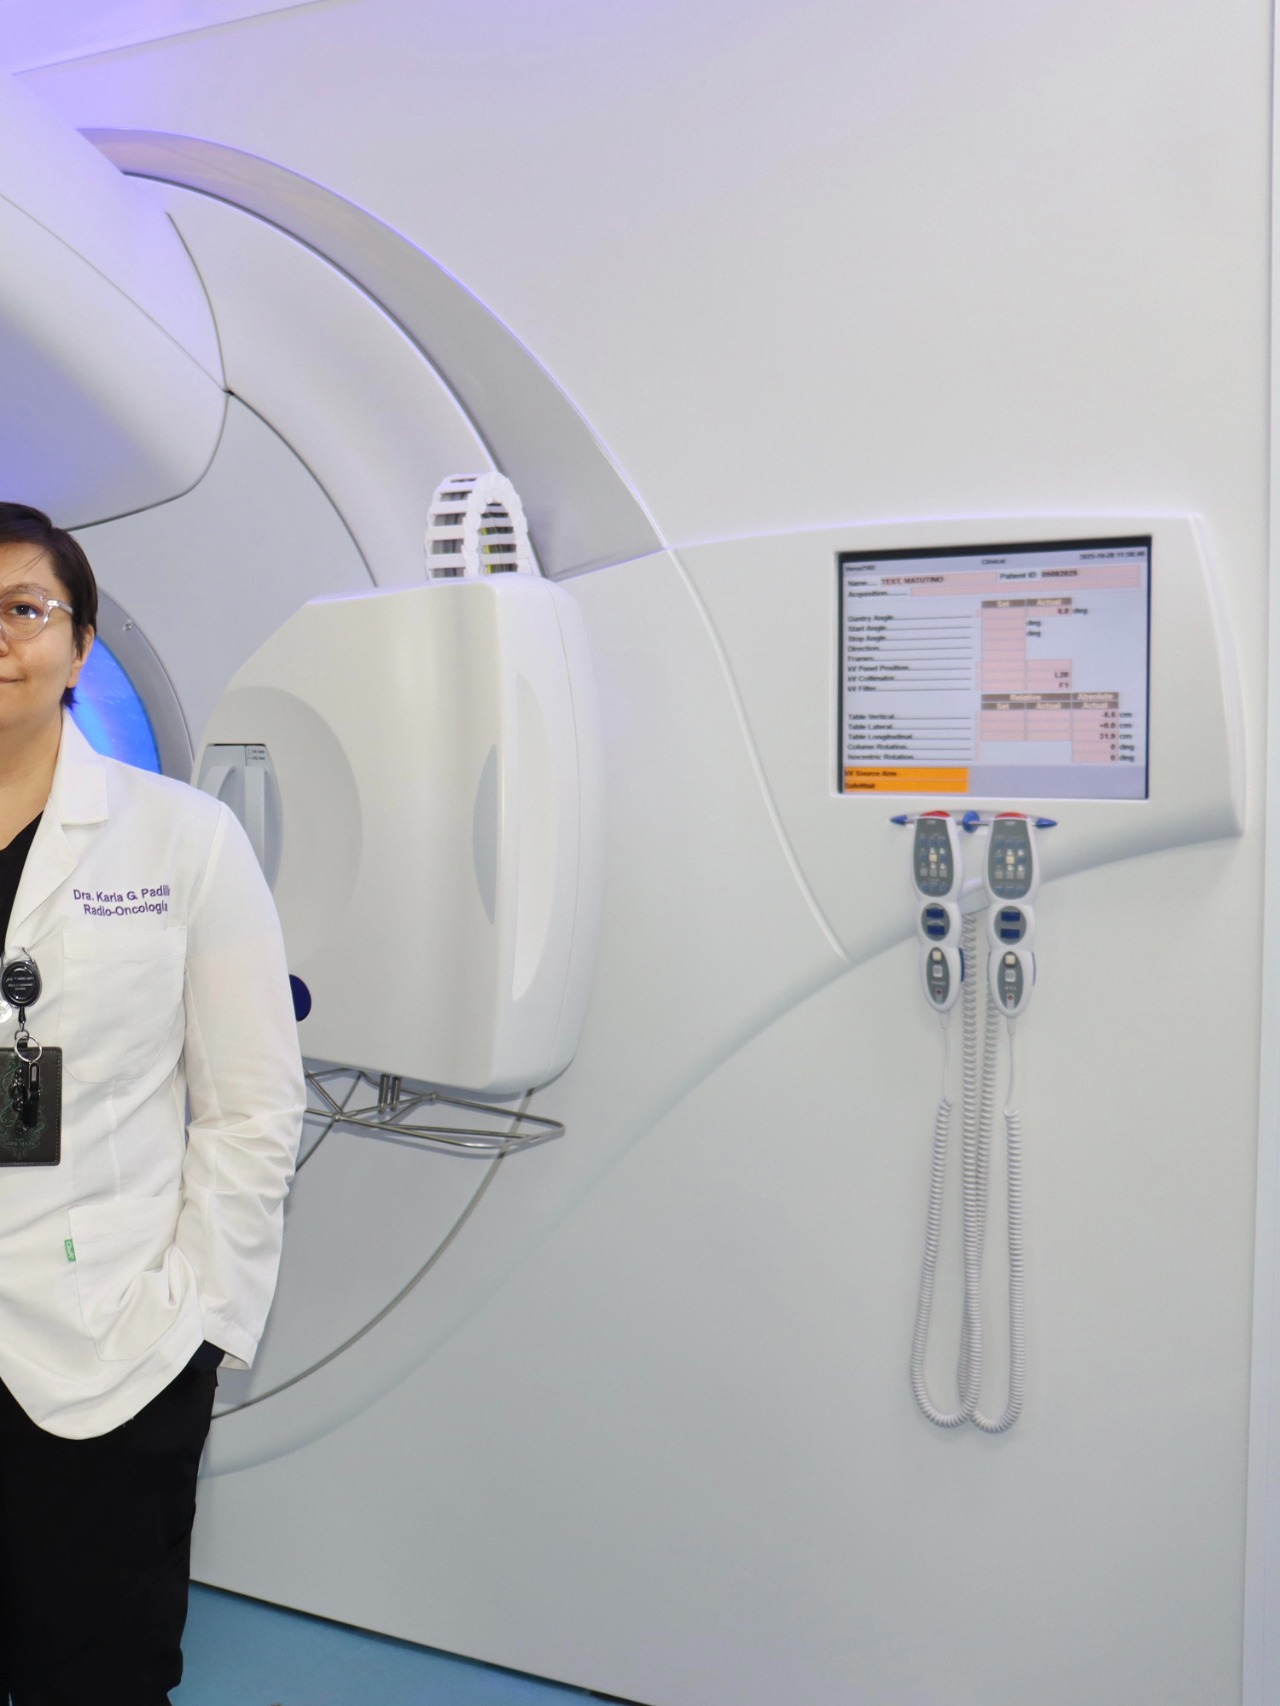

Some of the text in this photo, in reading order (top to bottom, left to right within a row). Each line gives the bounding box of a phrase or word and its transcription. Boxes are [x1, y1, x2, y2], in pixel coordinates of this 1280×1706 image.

[1073, 607, 1088, 615] deg
[873, 614, 894, 622] Angle
[1119, 744, 1135, 752] deg
[1119, 754, 1135, 762] deg
[73, 889, 94, 901] Dra.
[96, 891, 123, 902] Karla
